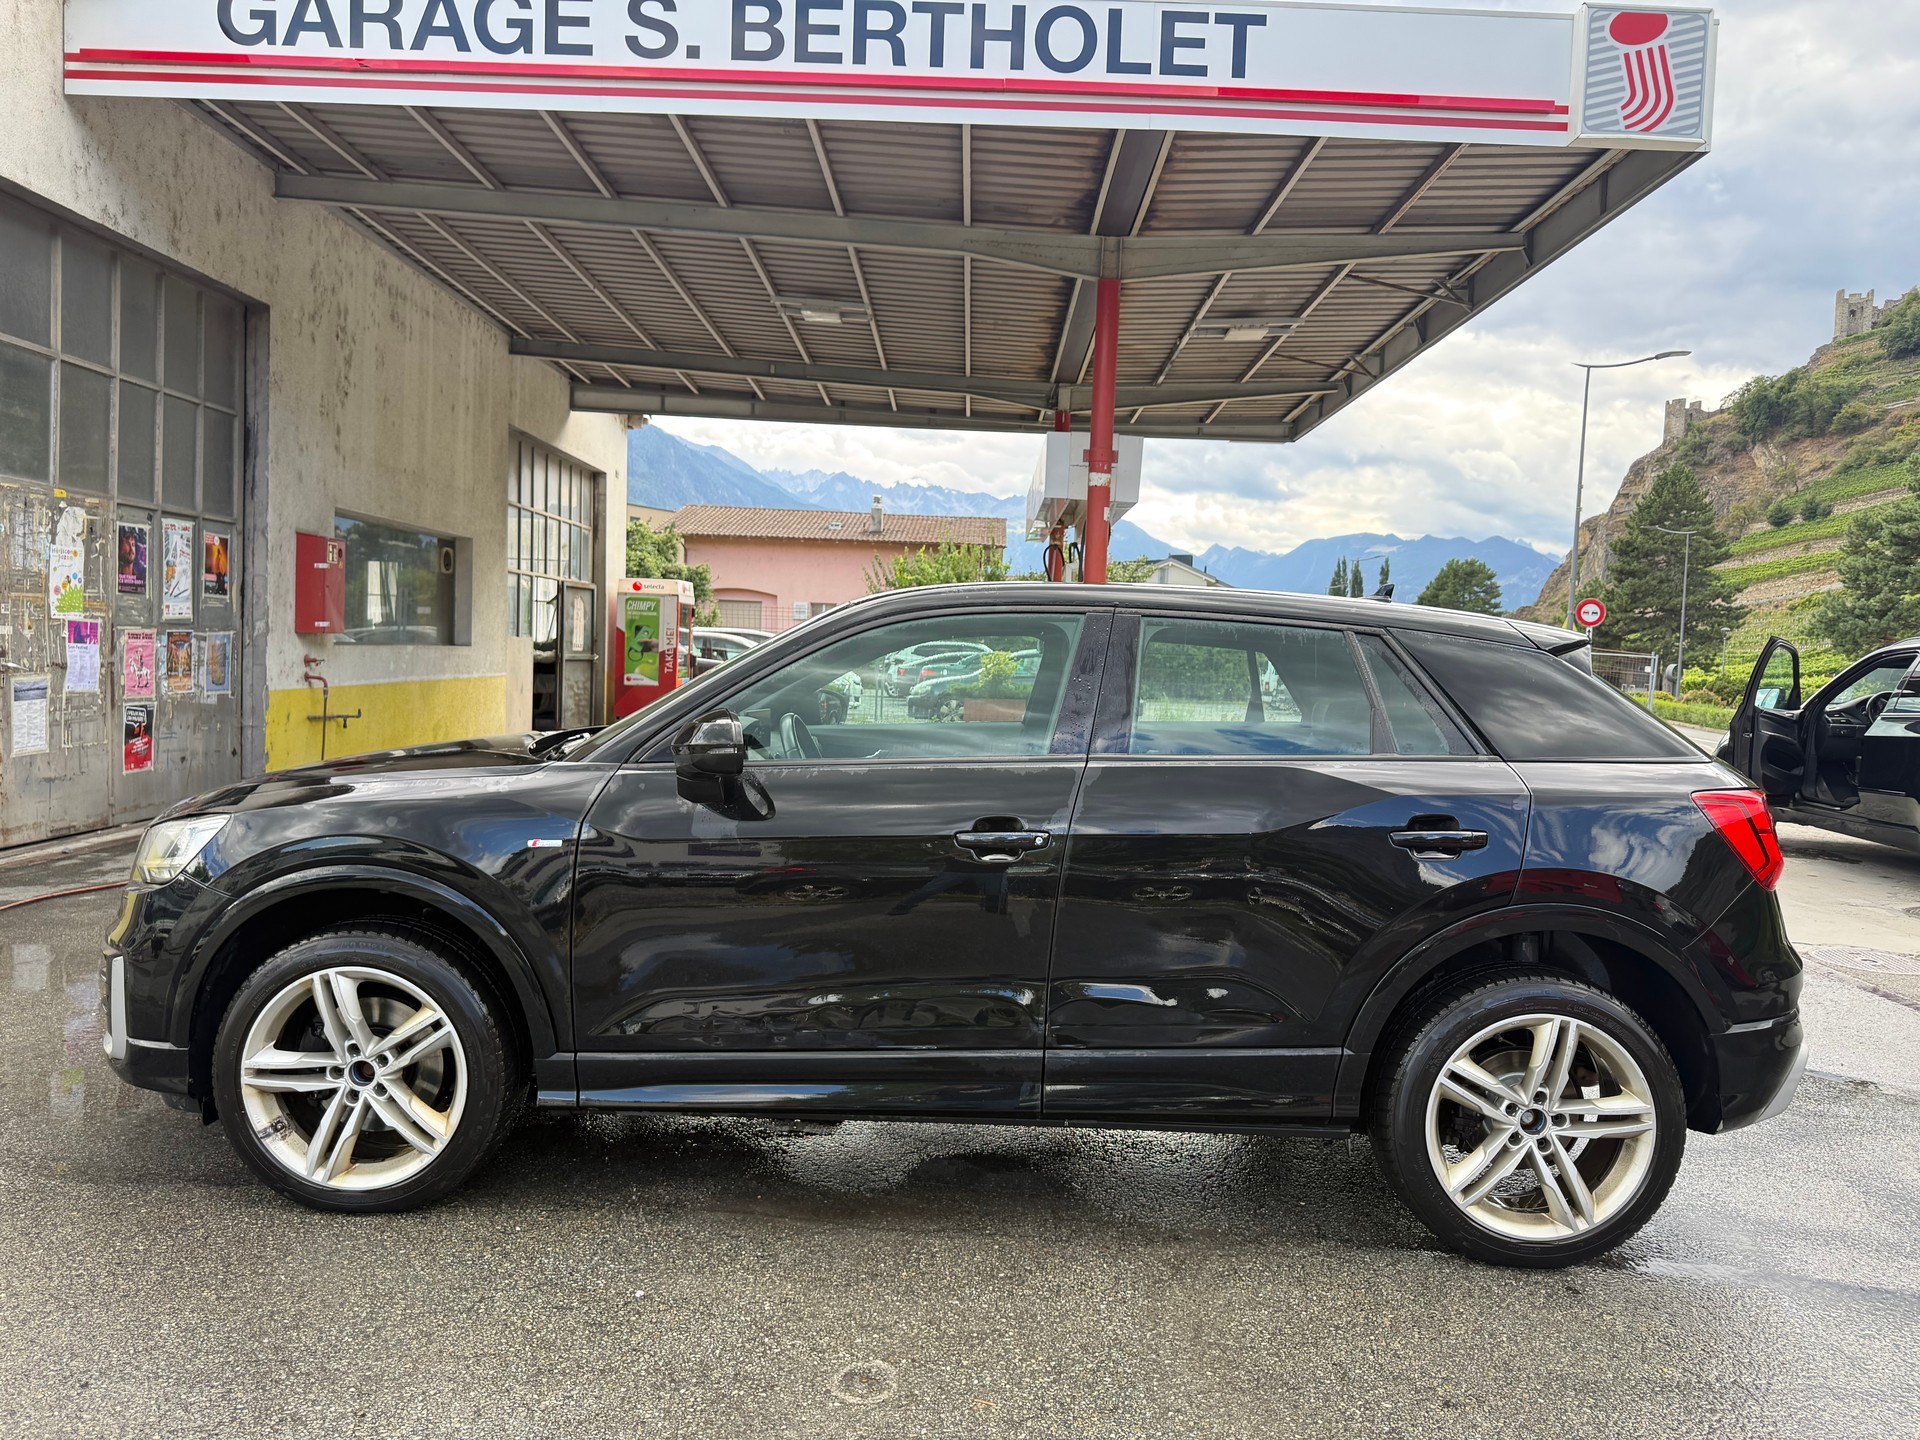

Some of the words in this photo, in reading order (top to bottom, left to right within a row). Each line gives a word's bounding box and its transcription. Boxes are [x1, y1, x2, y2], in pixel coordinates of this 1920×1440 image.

[217, 0, 594, 56] GARAGE
[625, 0, 700, 59] S.
[731, 0, 1267, 78] BERTHOLET
[626, 600, 657, 611] CHIMPY
[666, 627, 674, 646] ME!
[665, 648, 674, 673] TAKE
